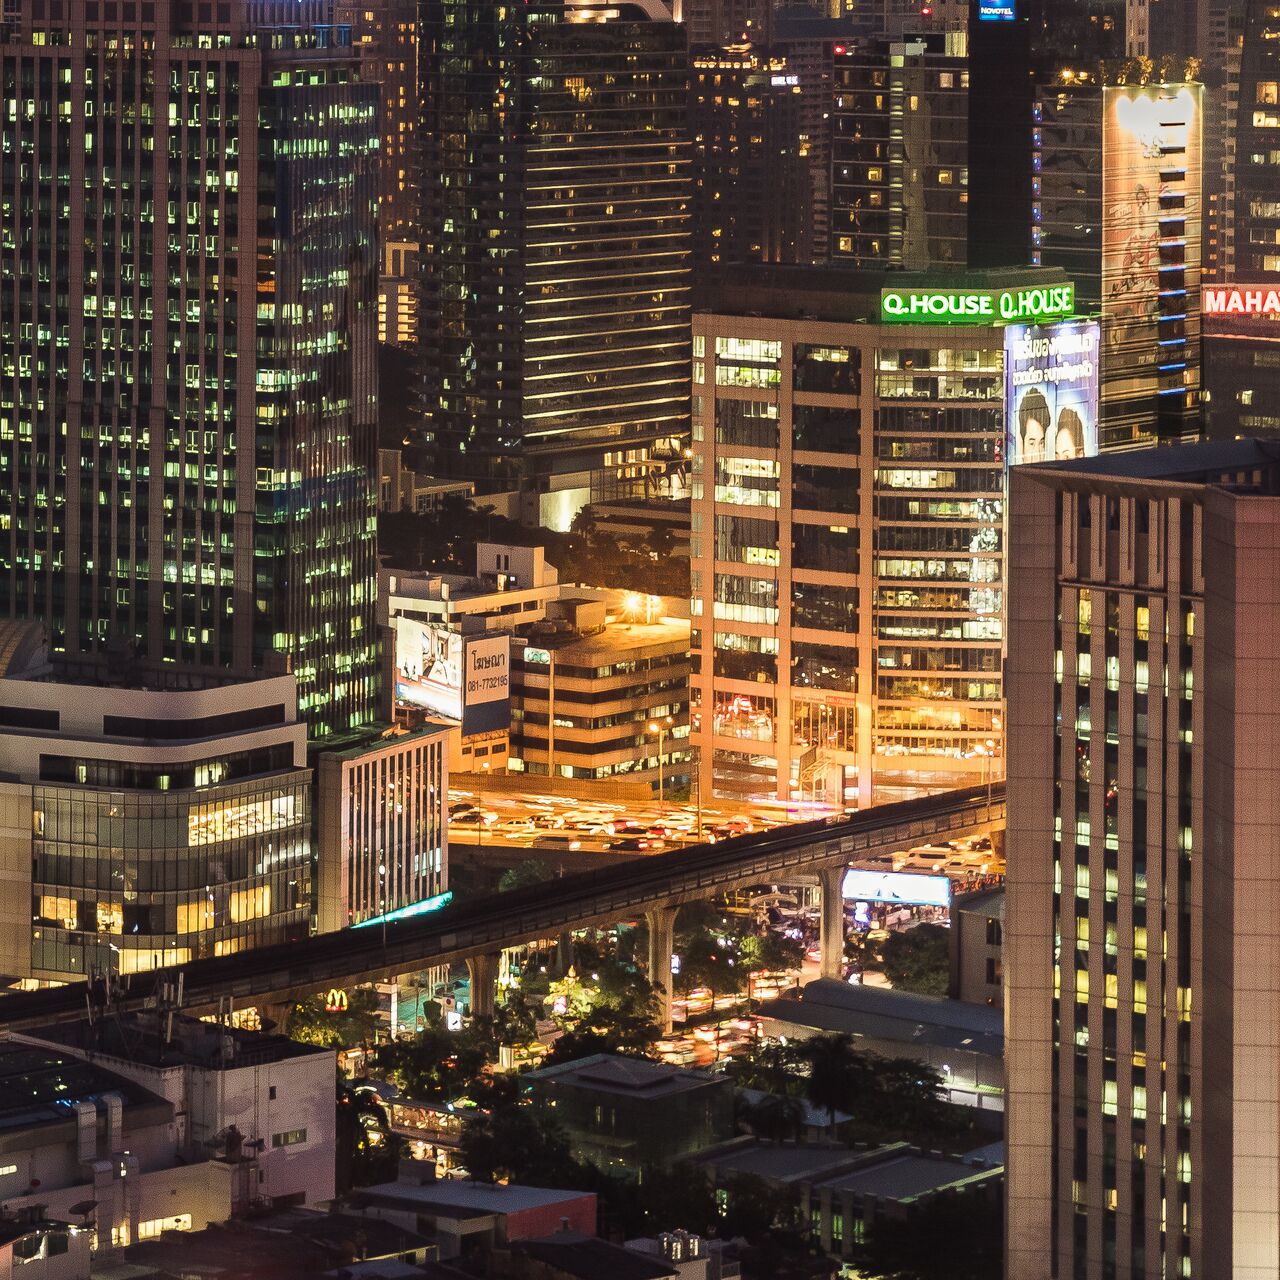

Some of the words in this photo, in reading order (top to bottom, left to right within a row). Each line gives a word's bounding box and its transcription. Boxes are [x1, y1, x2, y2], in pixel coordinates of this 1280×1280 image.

[981, 7, 1013, 15] NOVOTEL
[883, 294, 994, 315] Q.HOUSE
[999, 287, 1072, 318] Q.HOUSE
[472, 649, 506, 671] โฆษณา
